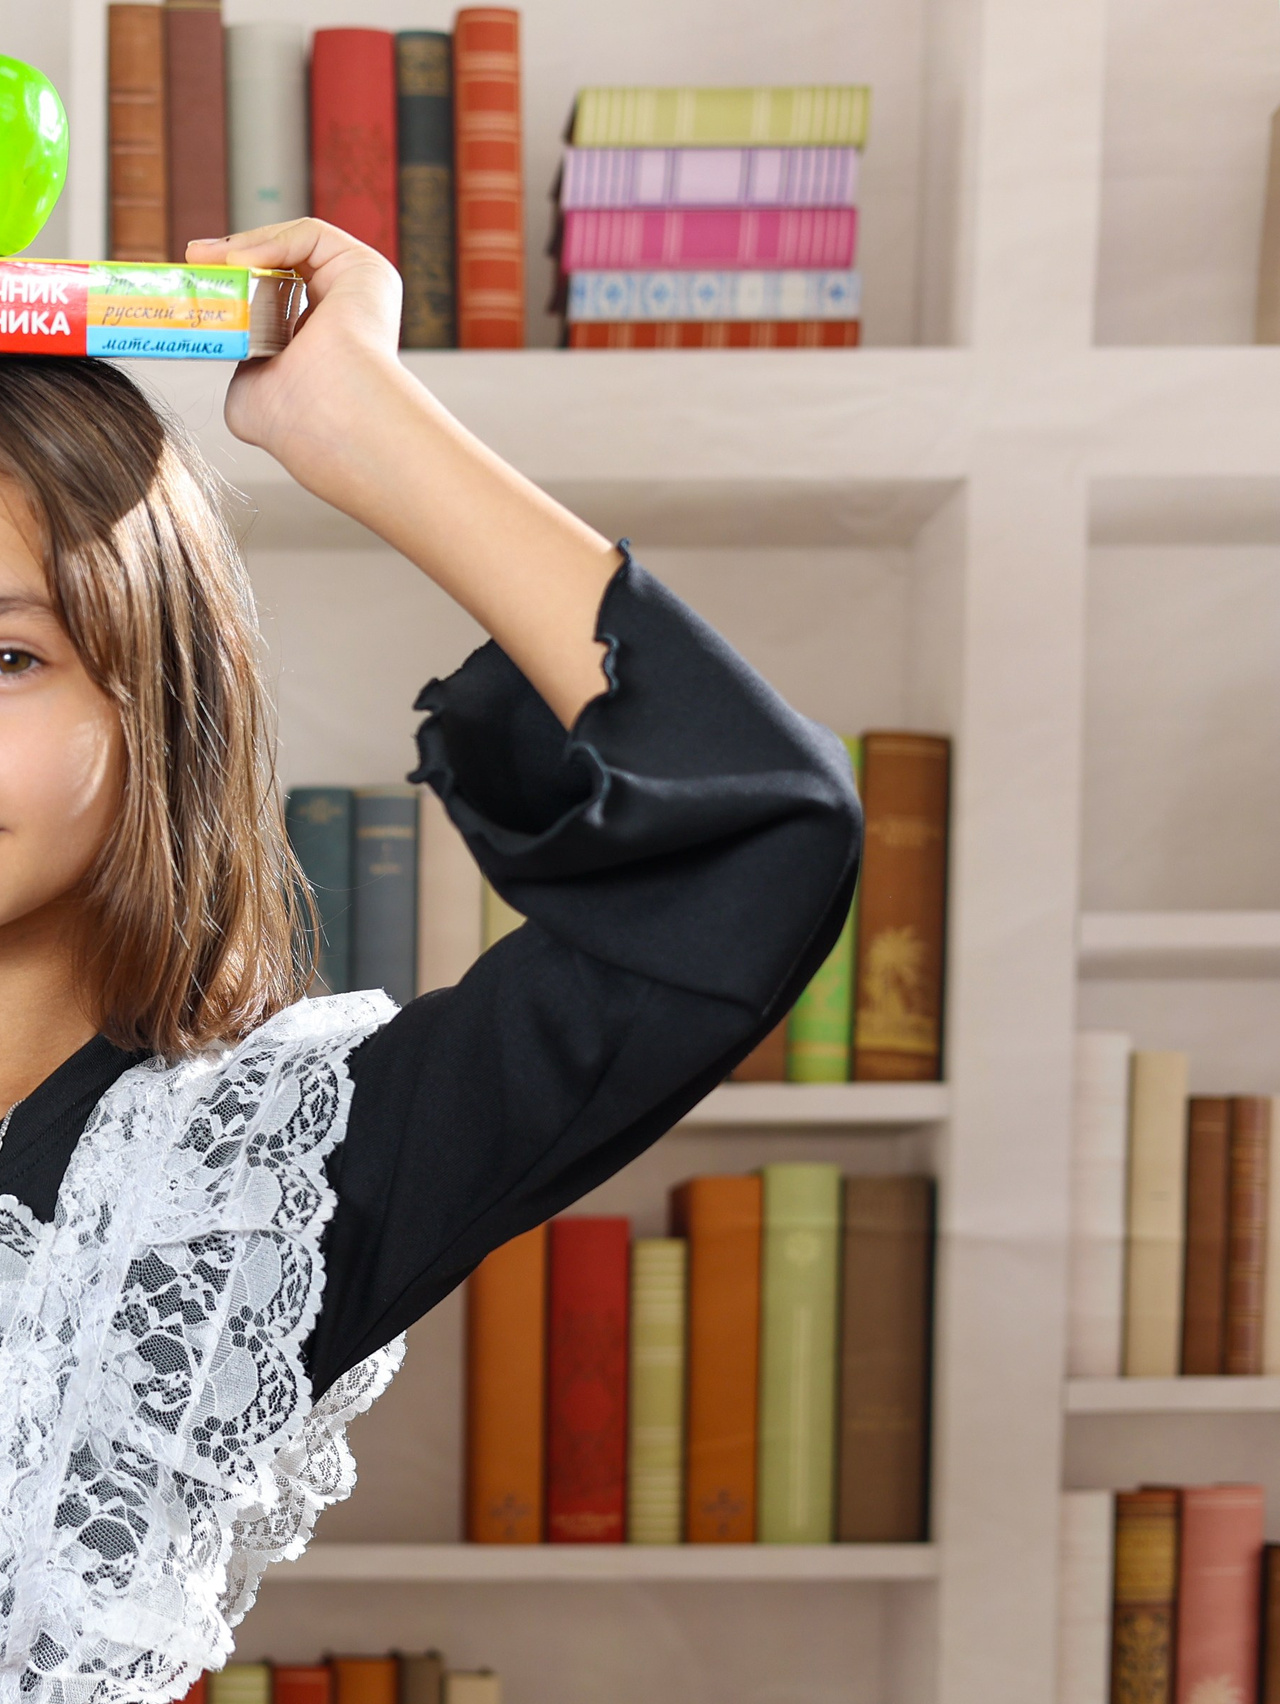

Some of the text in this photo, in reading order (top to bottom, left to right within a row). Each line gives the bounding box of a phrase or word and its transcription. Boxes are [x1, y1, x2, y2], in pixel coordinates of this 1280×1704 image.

[101, 305, 228, 328] русский язык
[101, 337, 225, 354] математика
